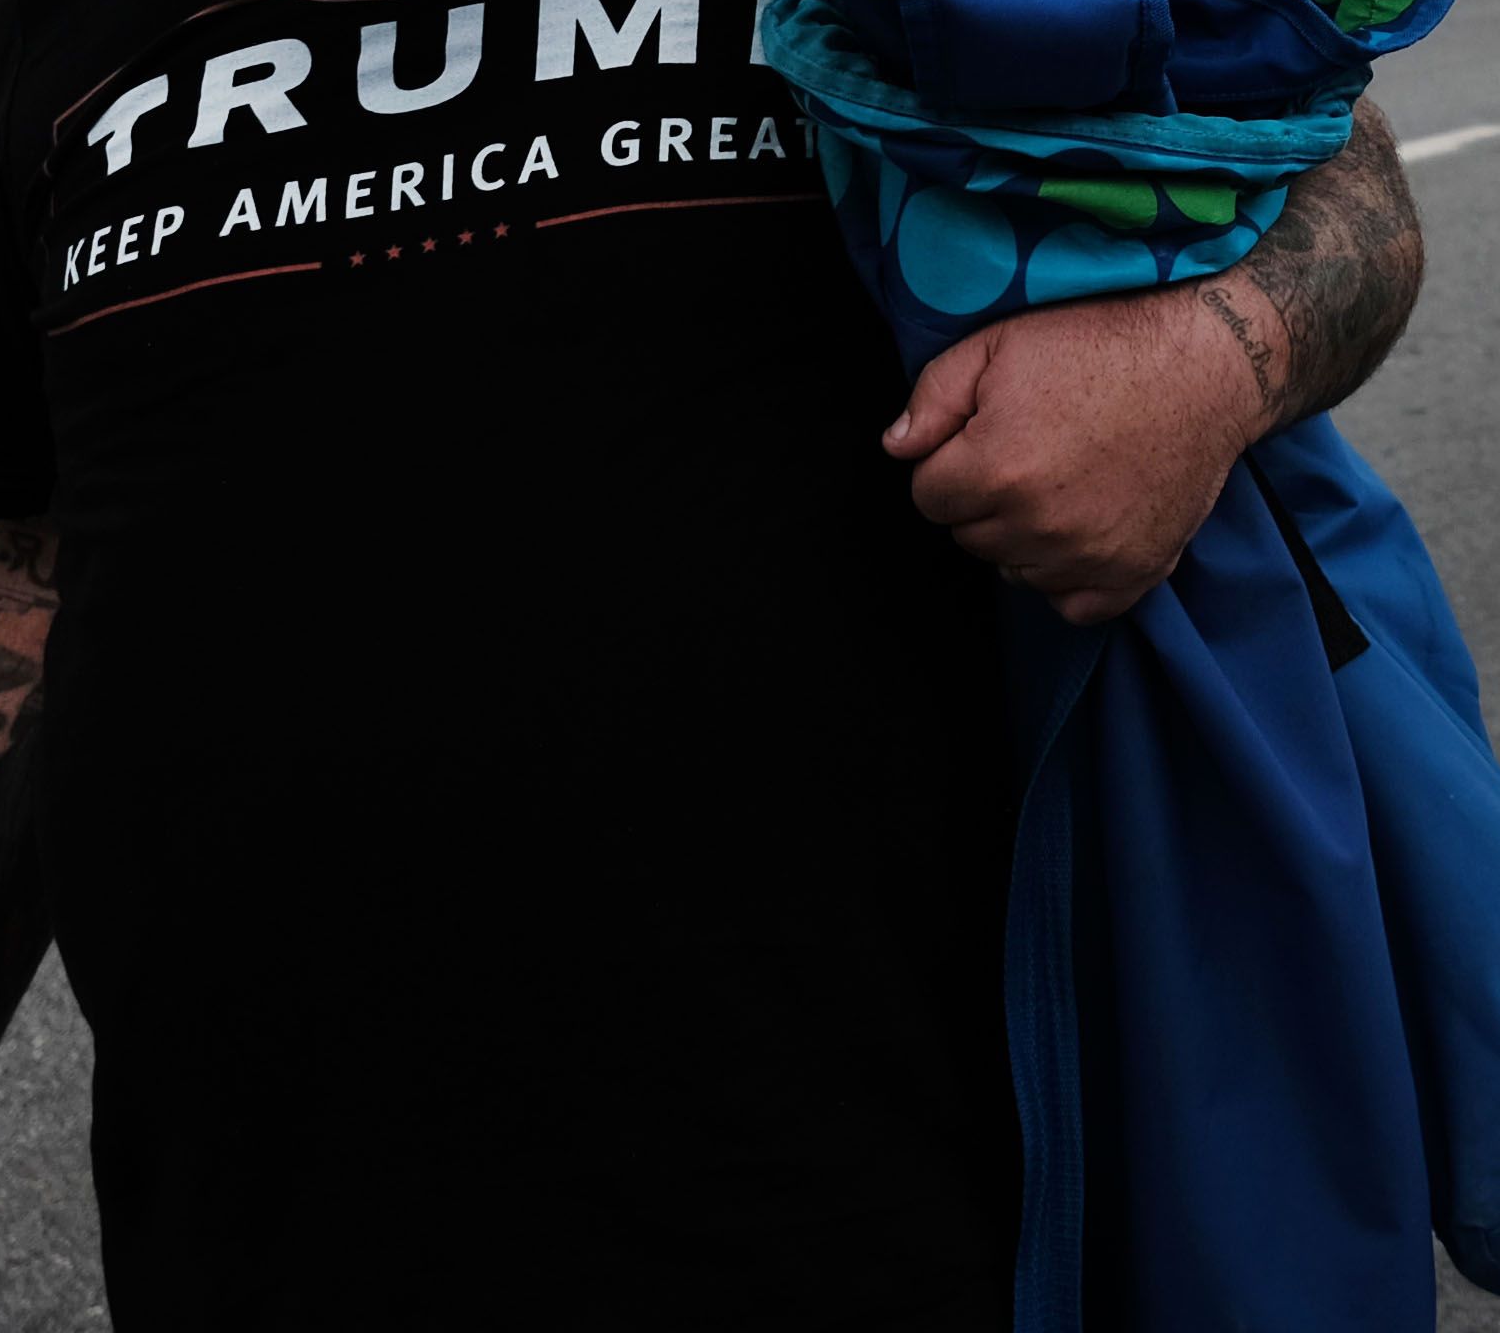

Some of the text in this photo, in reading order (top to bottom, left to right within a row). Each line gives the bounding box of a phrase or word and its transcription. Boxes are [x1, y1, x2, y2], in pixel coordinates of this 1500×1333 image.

[63, 116, 819, 291] KEEP AMERICA GREAT
